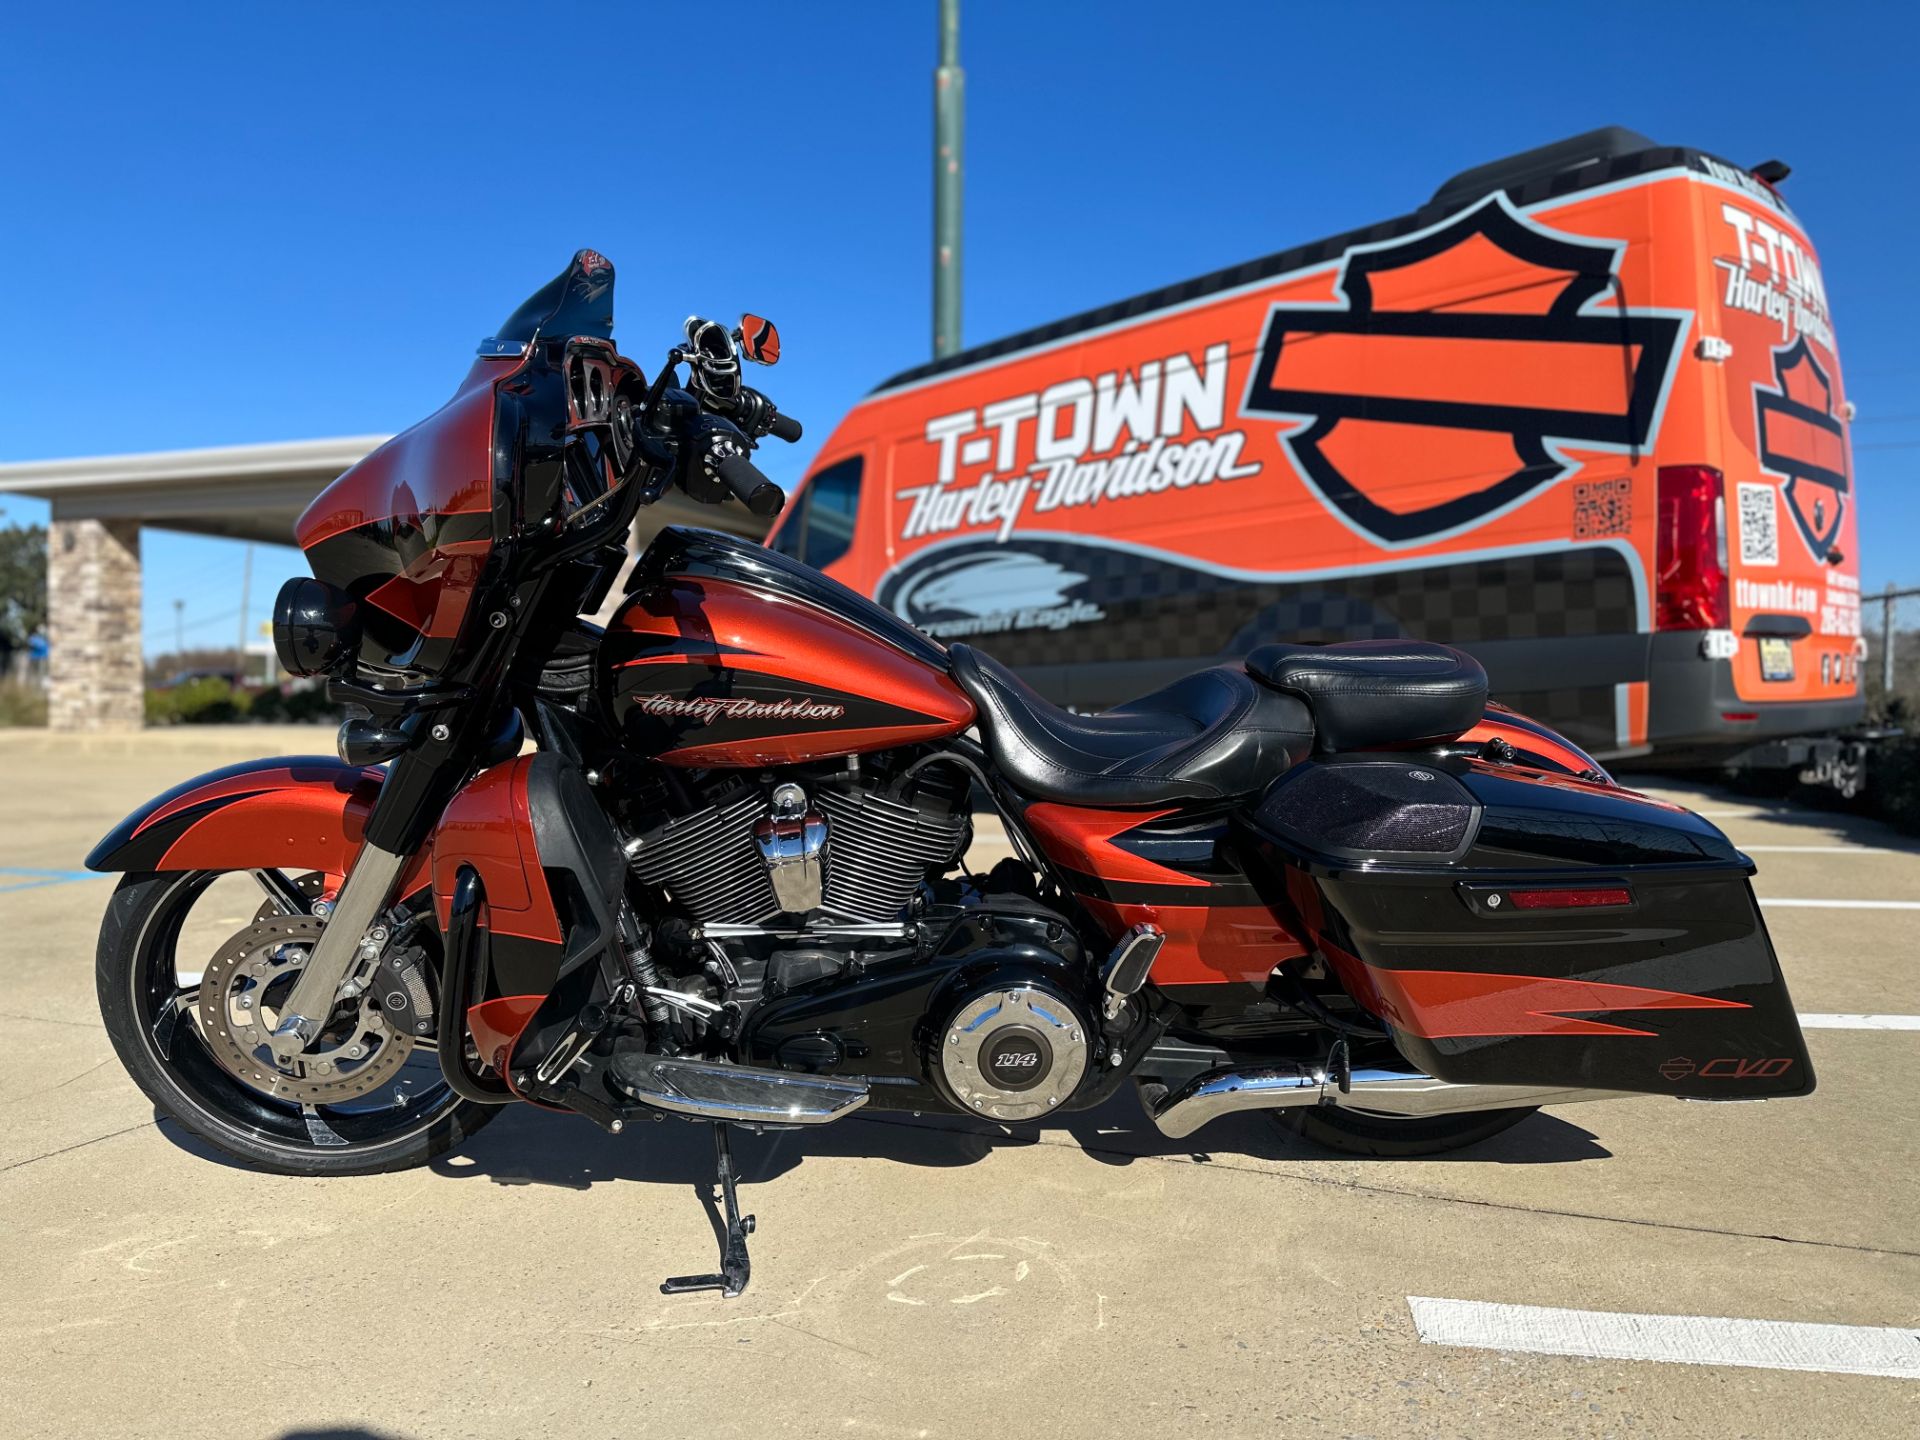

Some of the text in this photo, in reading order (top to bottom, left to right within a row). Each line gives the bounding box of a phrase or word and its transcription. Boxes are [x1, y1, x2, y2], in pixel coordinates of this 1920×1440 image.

[925, 341, 1230, 484] T-TOWN
[896, 430, 1263, 544] Harley-Davidson
[1014, 600, 1100, 631] Eagle
[632, 694, 845, 726] Harley-Davidson
[994, 1052, 1038, 1067] 114
[1698, 1058, 1794, 1079] CVO
